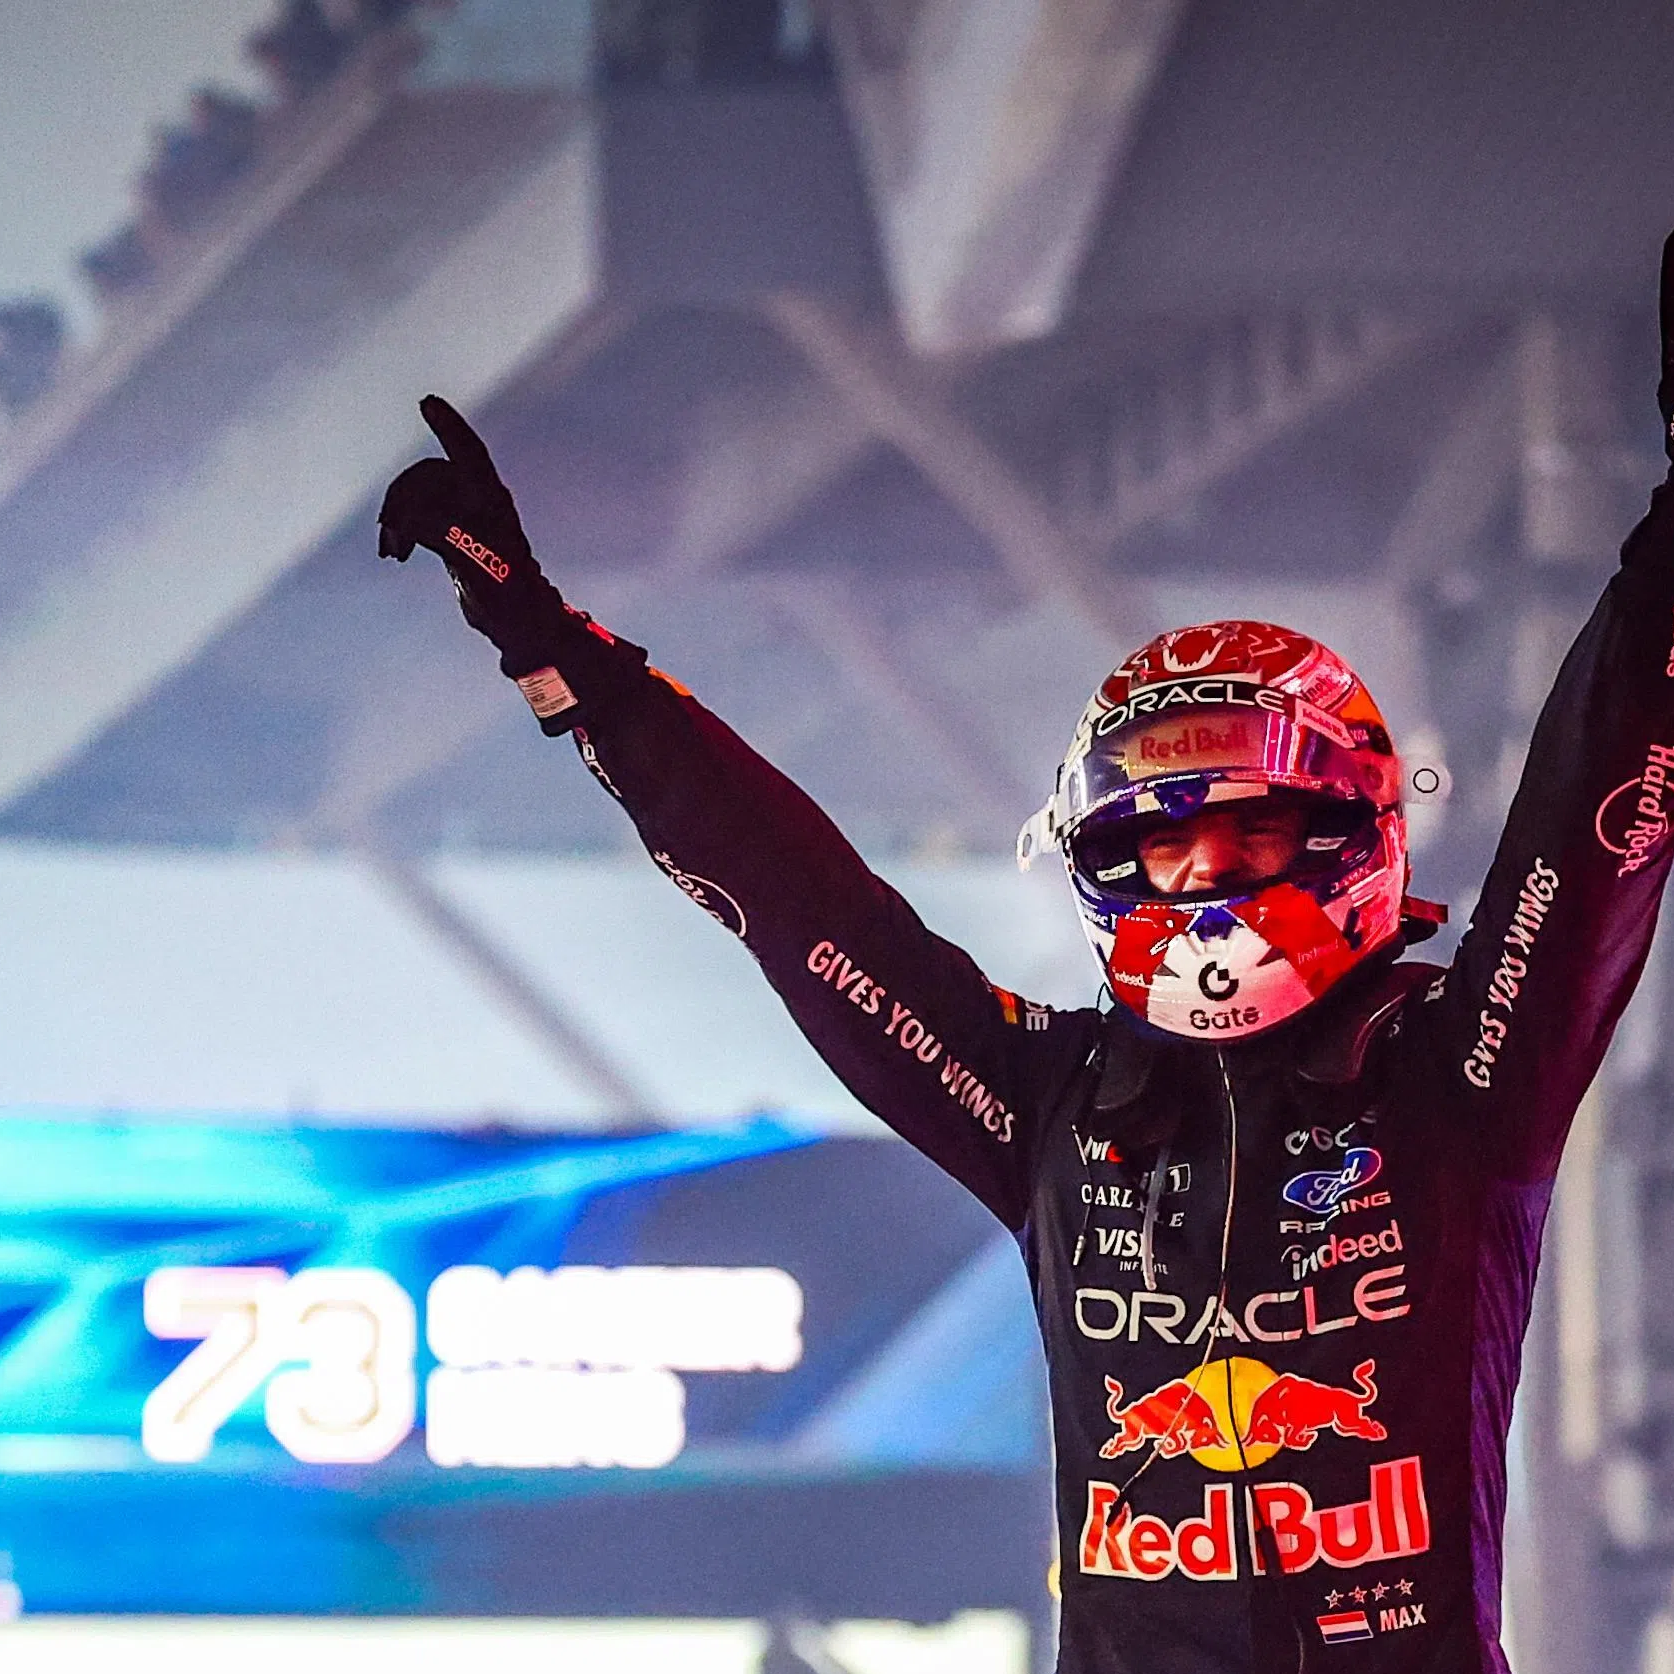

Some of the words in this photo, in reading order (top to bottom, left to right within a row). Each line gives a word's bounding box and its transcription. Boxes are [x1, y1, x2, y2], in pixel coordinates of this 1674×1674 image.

[445, 526, 509, 583] sparco
[1097, 682, 1286, 737] ORACLE
[1140, 729, 1193, 760] Red
[1196, 723, 1252, 756] Bull
[1617, 819, 1665, 878] Rock
[1503, 856, 1560, 956] WINGS
[1487, 949, 1527, 1013] YOU
[807, 941, 887, 1014] GIVES
[884, 1001, 943, 1063] YOU
[940, 1055, 1015, 1143] WINGS
[1189, 1004, 1260, 1031] Gate
[1464, 1010, 1507, 1088] GVES
[1081, 1183, 1185, 1228] CARLE
[1281, 1219, 1404, 1281] indeed
[1074, 1264, 1411, 1345] ORACLE
[1079, 1480, 1238, 1581] Red
[1246, 1455, 1430, 1576] Bull
[1379, 1604, 1427, 1632] MAX
